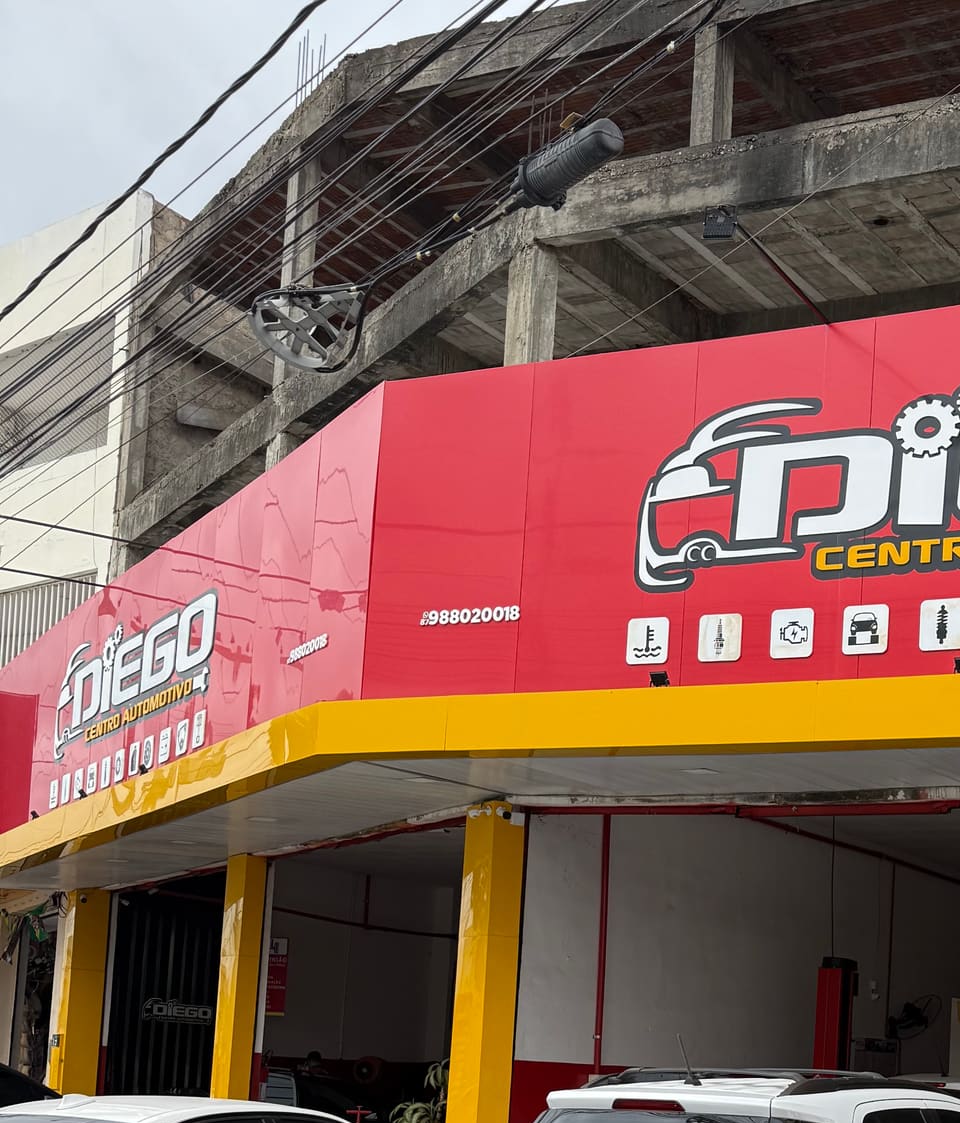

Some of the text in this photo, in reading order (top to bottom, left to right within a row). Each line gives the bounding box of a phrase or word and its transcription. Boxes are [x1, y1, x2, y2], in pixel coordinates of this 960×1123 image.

[429, 605, 520, 625] 988020018
[84, 677, 193, 742] CENTRO AUTOMOTIVO
